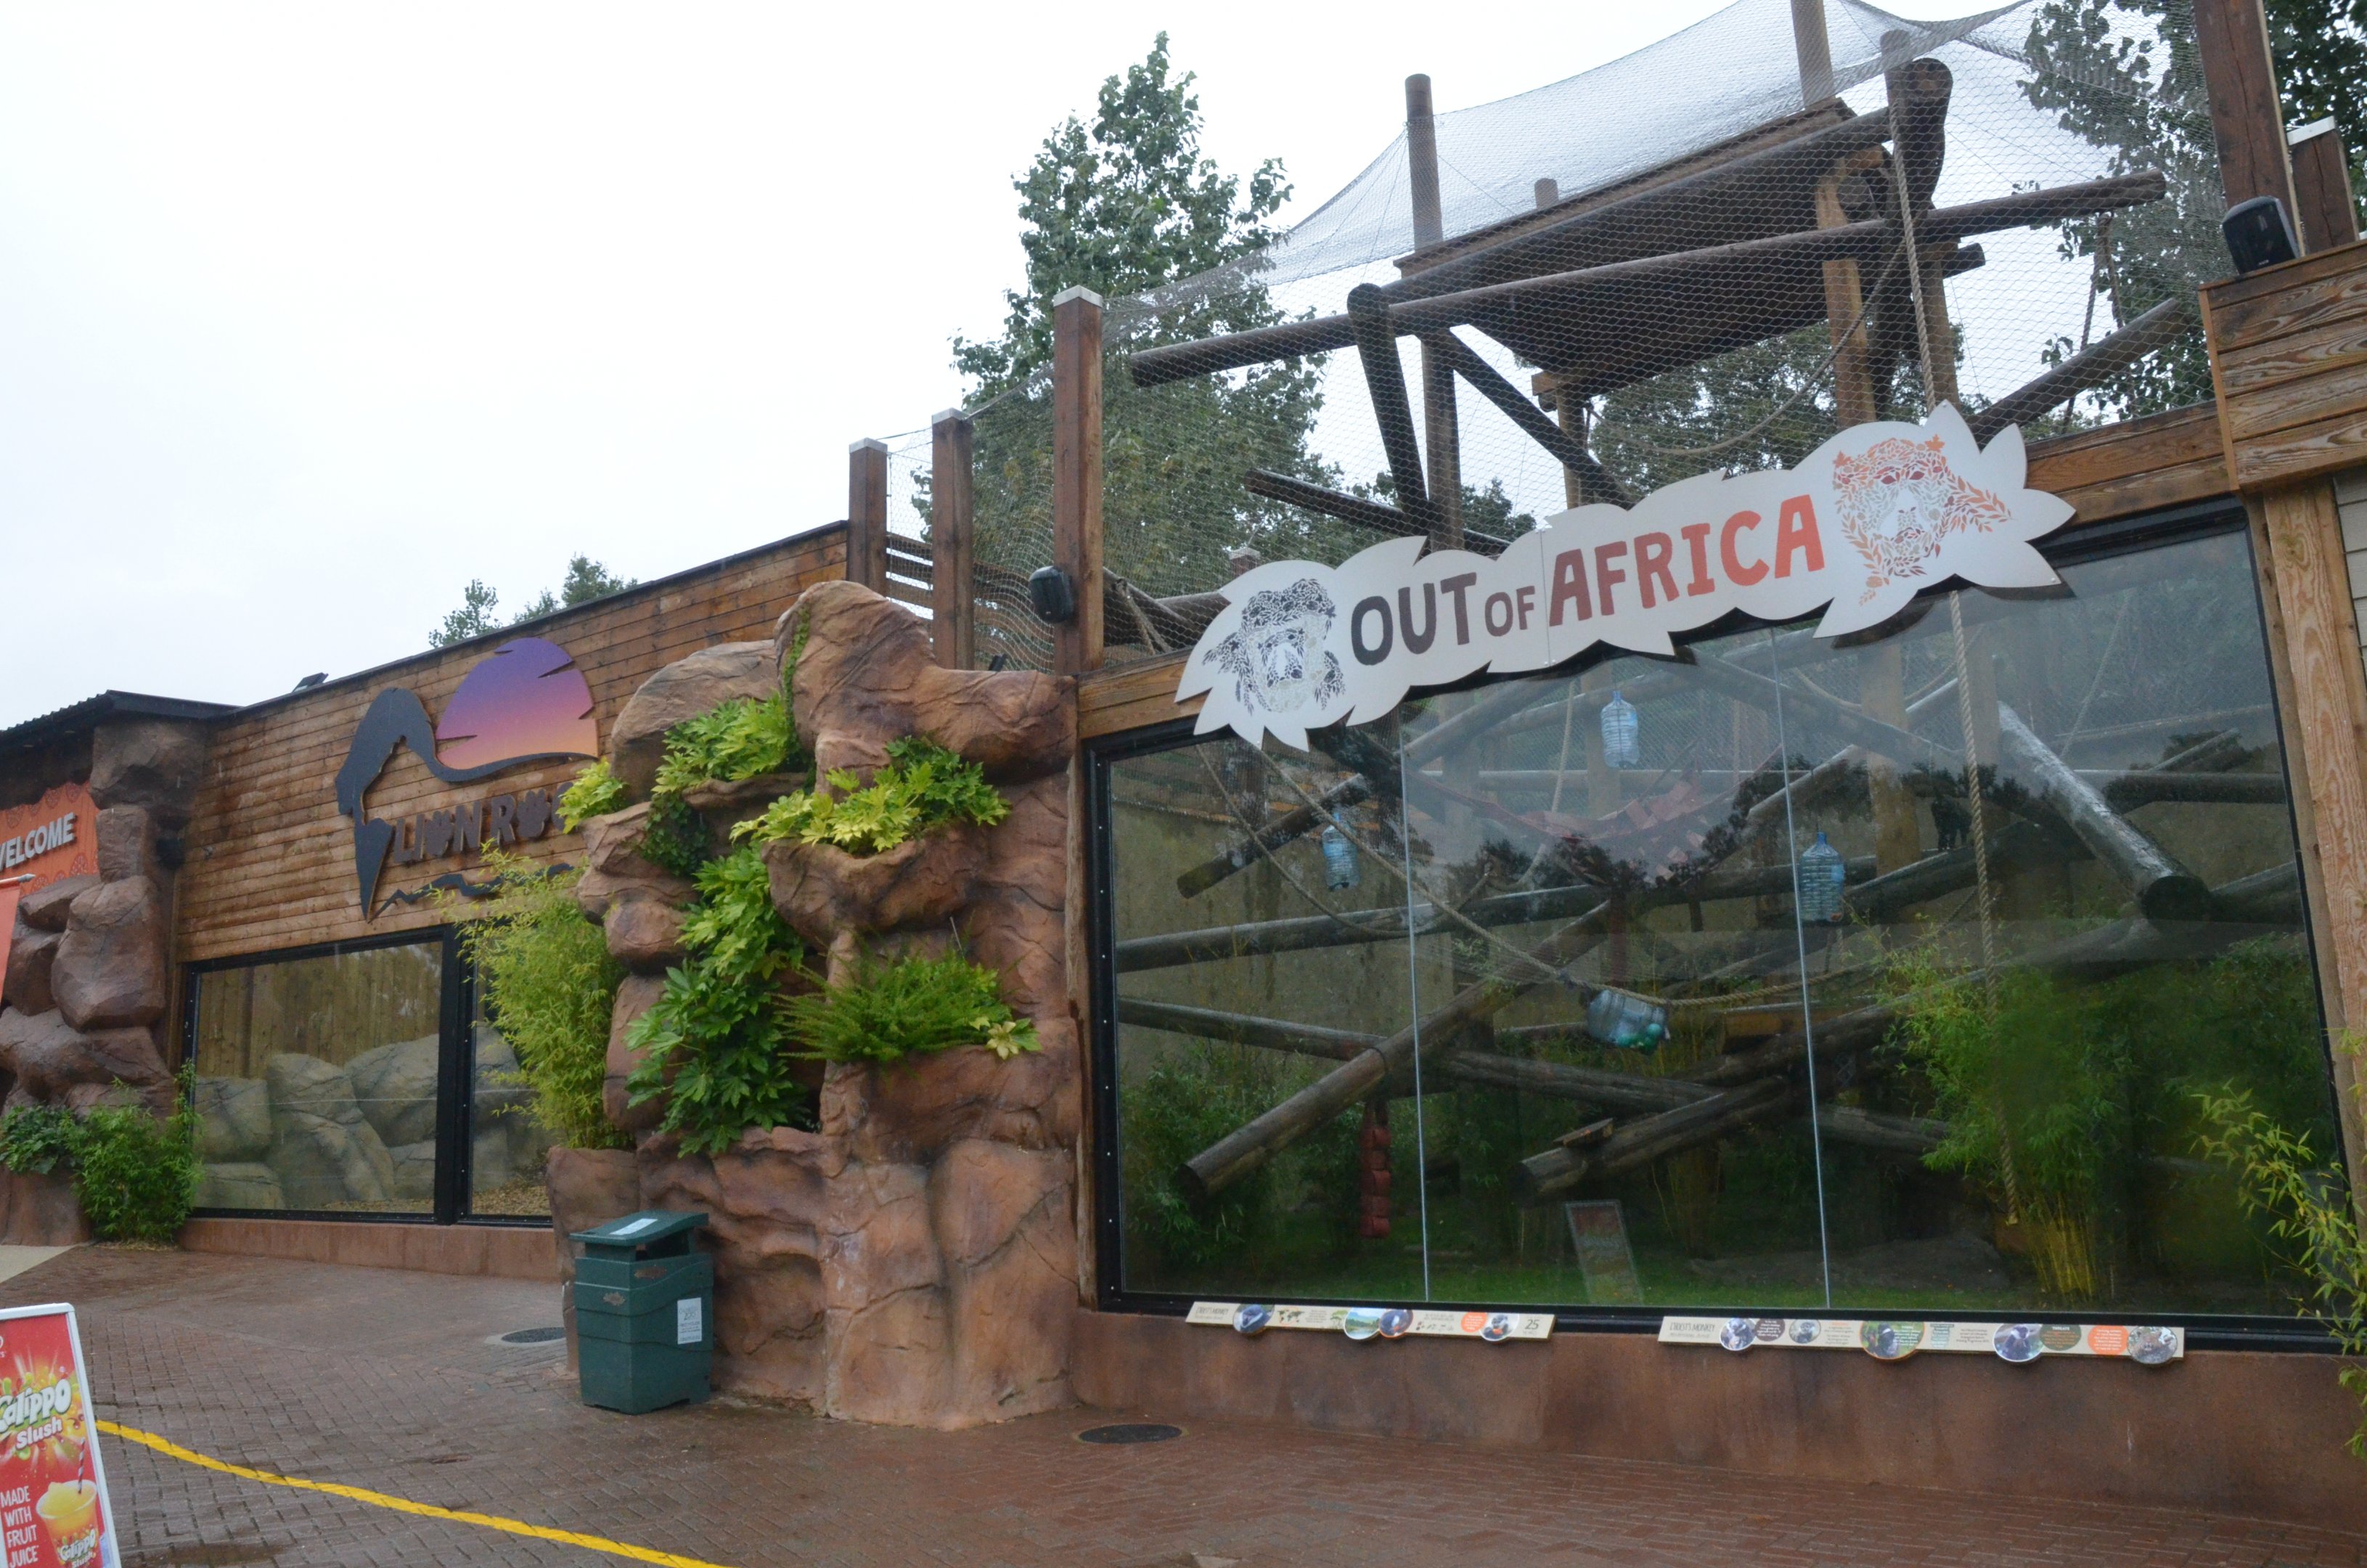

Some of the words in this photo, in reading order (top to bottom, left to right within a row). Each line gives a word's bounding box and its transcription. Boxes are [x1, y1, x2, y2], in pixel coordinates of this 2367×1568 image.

[1351, 571, 1477, 666] OUT
[1484, 586, 1536, 637] OF
[1549, 494, 1827, 626] AFRICA
[1524, 1318, 1540, 1330] 25
[16, 1416, 63, 1450] slush
[0, 1485, 30, 1508] MADE
[4, 1506, 32, 1527] WITH
[7, 1524, 37, 1548] FRUIT
